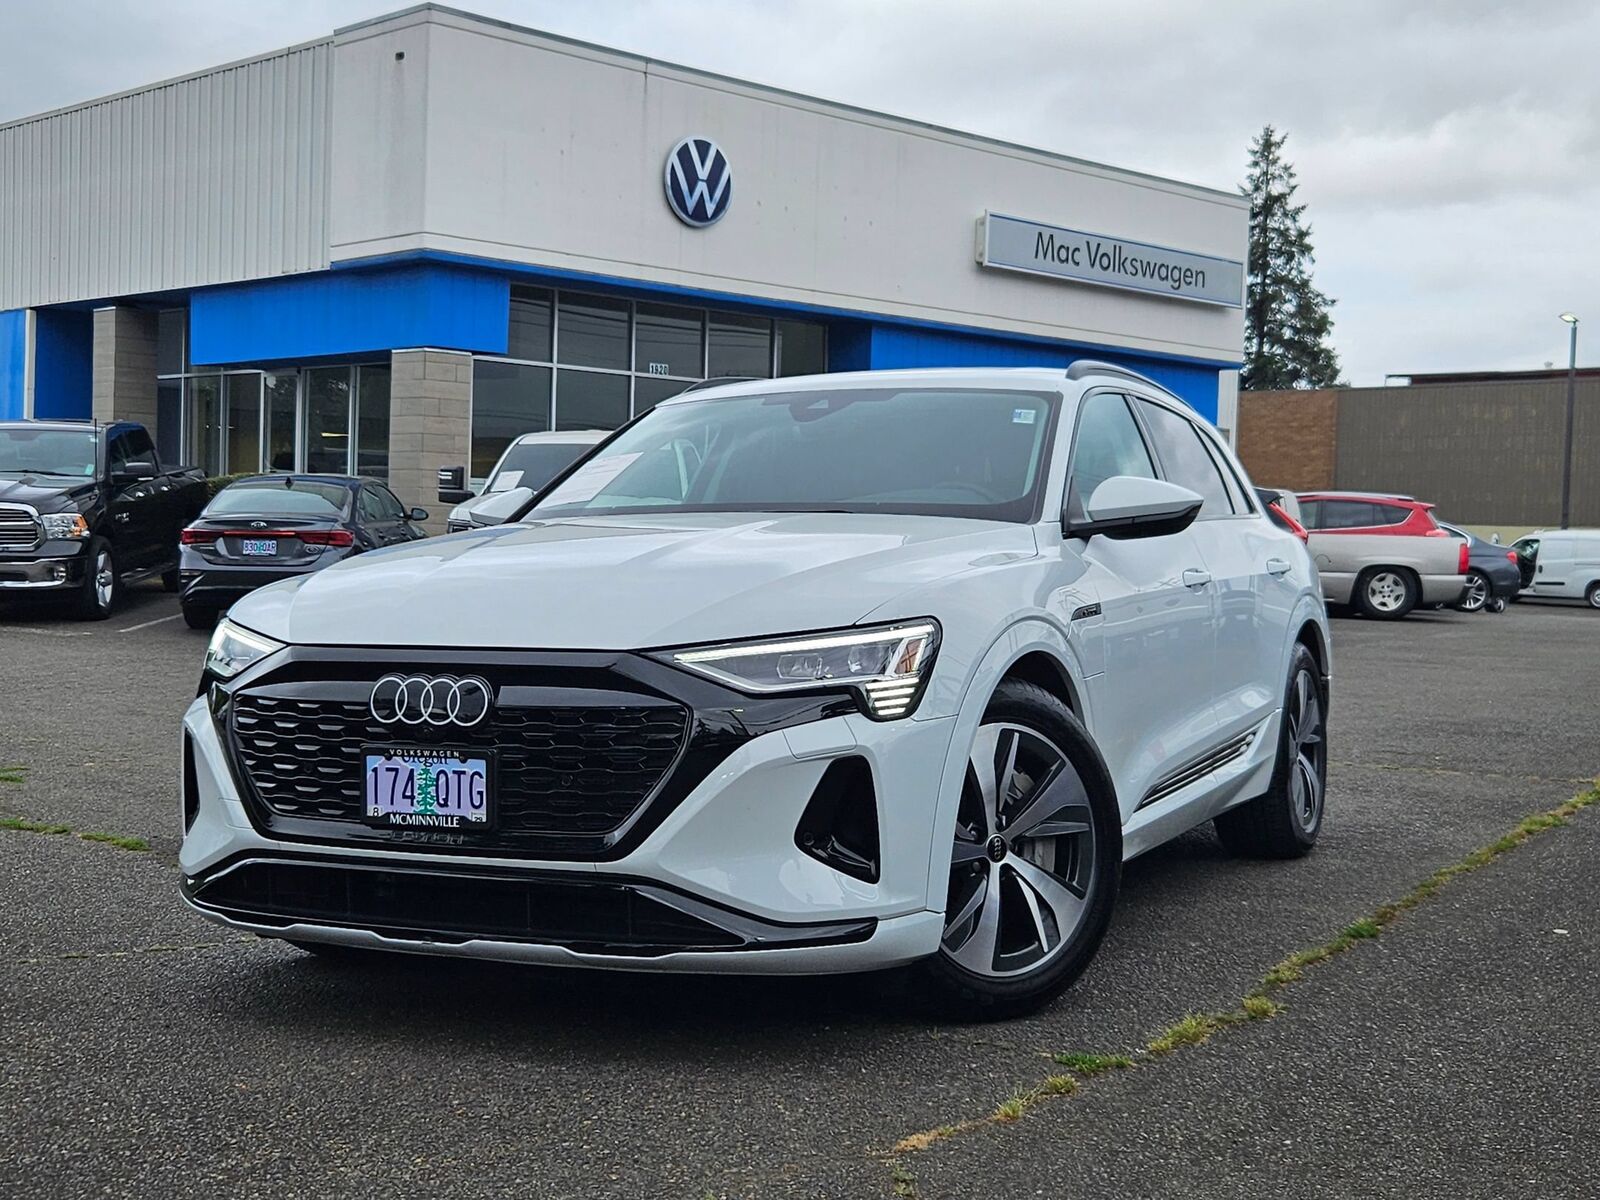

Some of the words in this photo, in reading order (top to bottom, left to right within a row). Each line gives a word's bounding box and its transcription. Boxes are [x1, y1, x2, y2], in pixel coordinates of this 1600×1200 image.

[1034, 231, 1080, 267] Mac
[1085, 240, 1206, 290] Volkswagen
[389, 749, 460, 758] VOLKSWAGEN
[371, 766, 416, 807] 174
[435, 769, 485, 810] QTG
[389, 813, 461, 828] MCMINNVILLE
